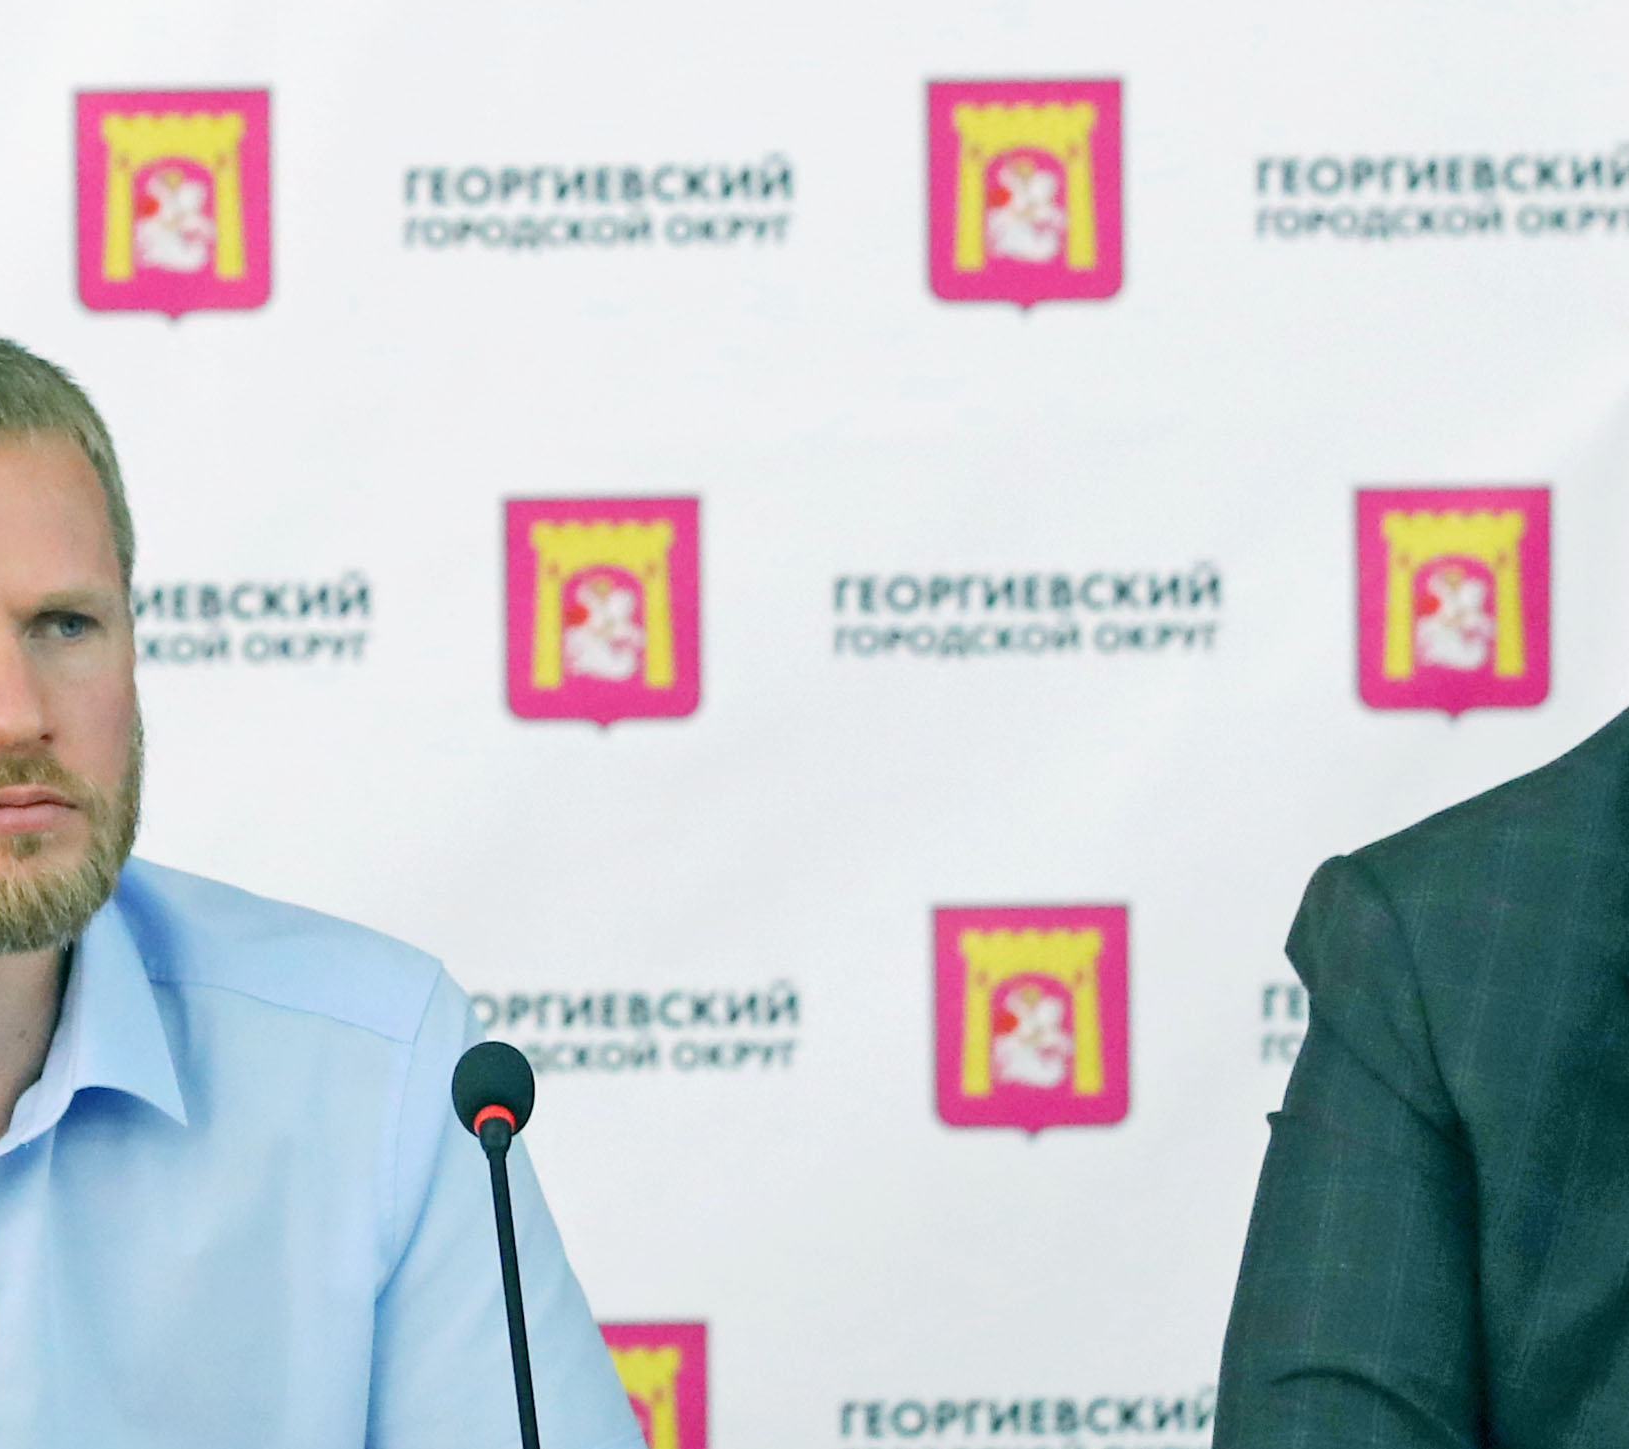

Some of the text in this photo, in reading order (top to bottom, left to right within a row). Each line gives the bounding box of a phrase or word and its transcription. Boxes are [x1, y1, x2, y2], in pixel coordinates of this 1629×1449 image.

[404, 154, 794, 205] ГЕОРГИЕВСКИЙ
[405, 213, 789, 249] ГОРОДСКОЙ ОКРУГ
[1256, 204, 1504, 239] ГОРОДСКОЙ
[132, 570, 371, 620] ИЕВСКИЙ
[833, 562, 1222, 613] ГЕОРГИЕВСКИЙ
[243, 631, 368, 661] ОКРУГ
[834, 622, 1217, 657] ГОРОДСКОЙ ОКРУГ
[470, 977, 801, 1029] ОРГИЕВСКИЙ
[524, 1034, 798, 1075] ДСКОЙ ОКРУГ
